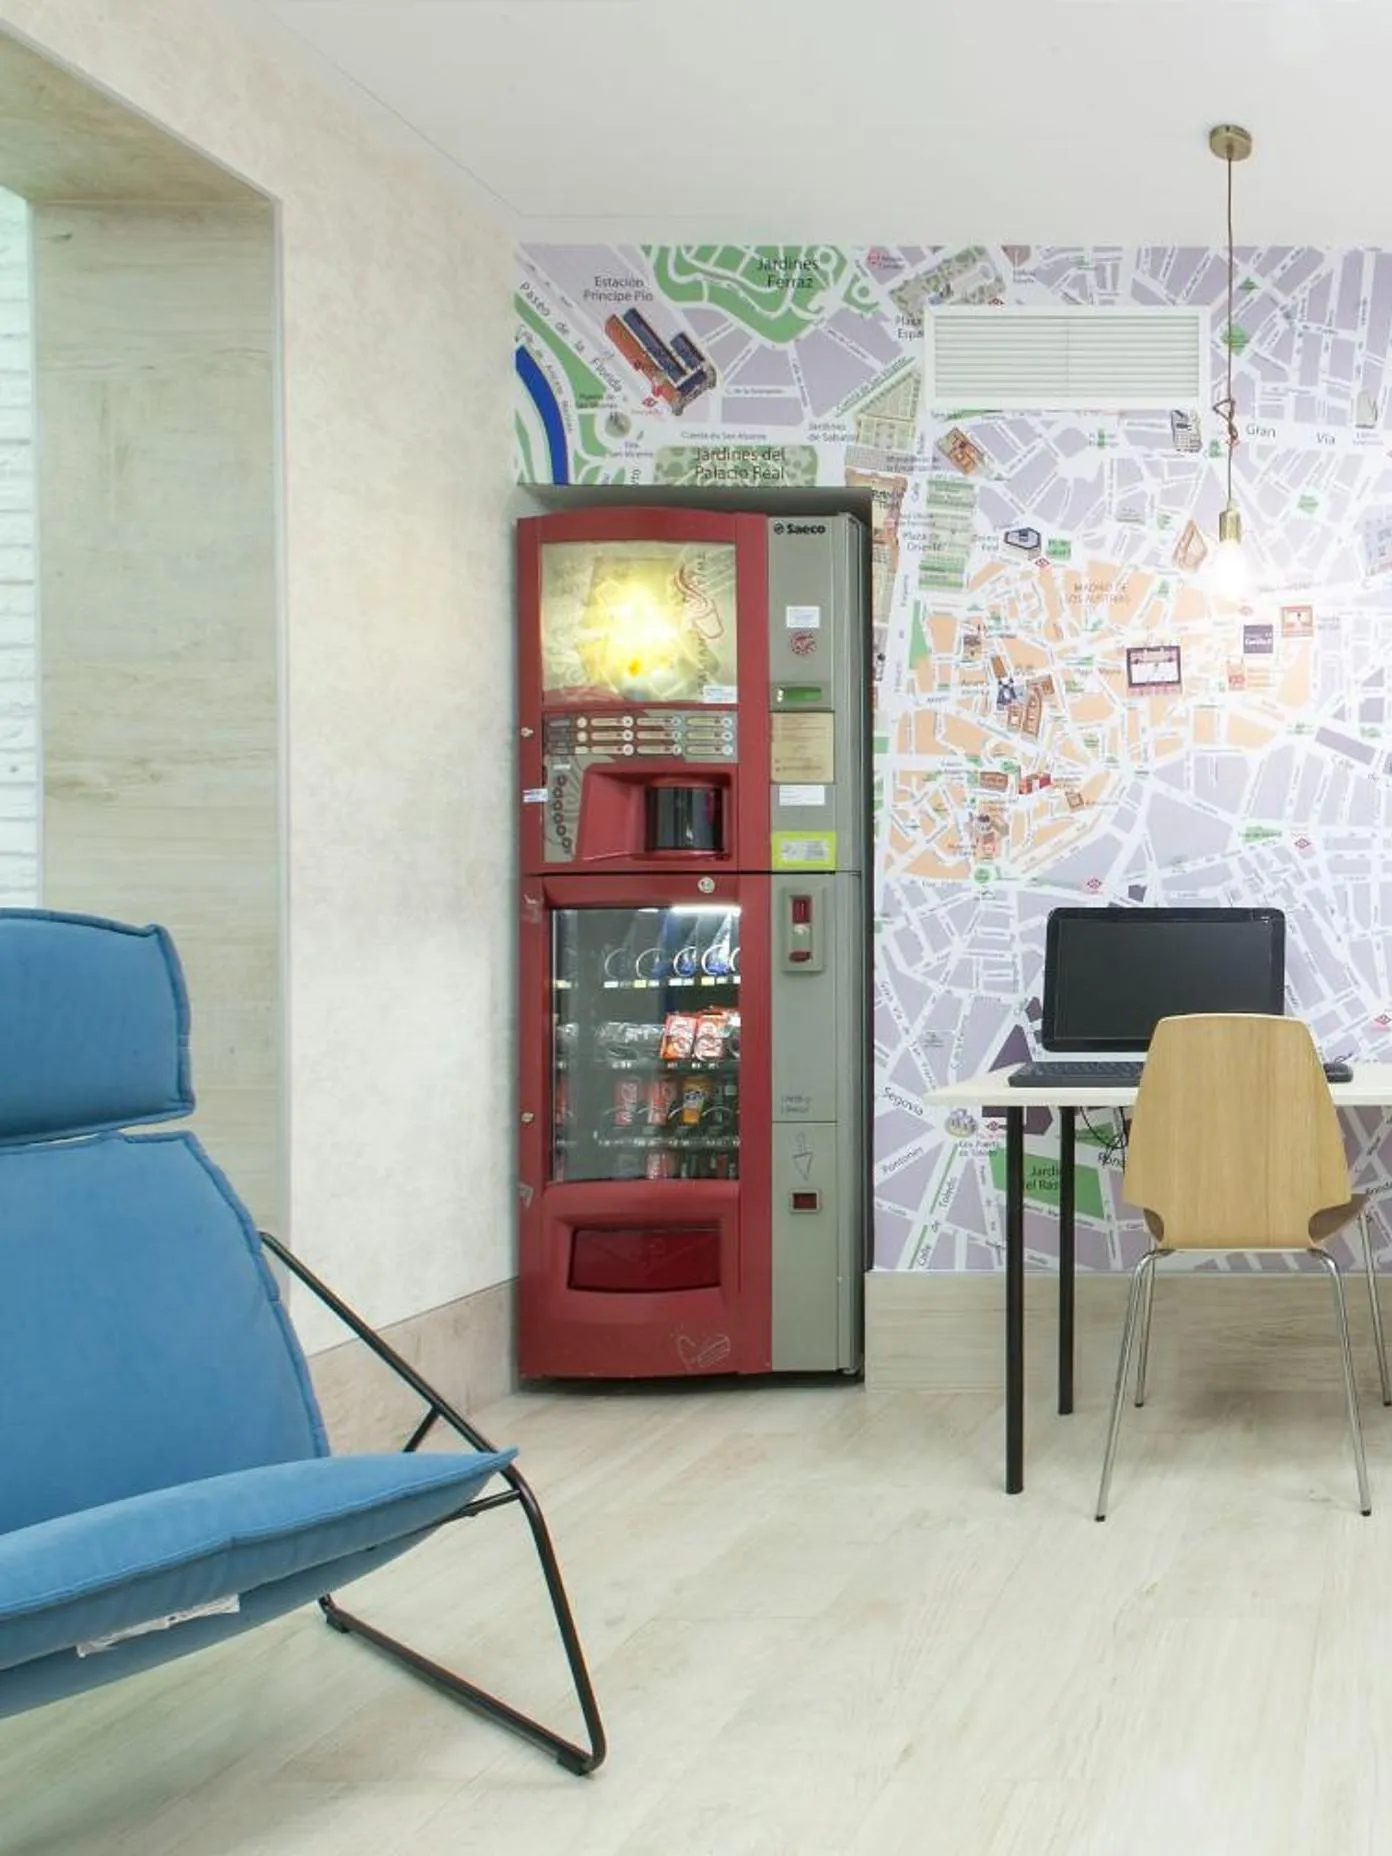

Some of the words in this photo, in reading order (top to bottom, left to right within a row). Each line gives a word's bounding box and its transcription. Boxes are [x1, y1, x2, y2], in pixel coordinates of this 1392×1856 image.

[756, 256, 820, 271] Jardines
[767, 274, 814, 289] Ferraz
[1245, 424, 1277, 438] Gran
[694, 446, 757, 462] Jardines
[762, 446, 786, 462] del
[694, 465, 749, 480] Palacio
[753, 465, 785, 480] Real
[787, 523, 826, 535] Saeco
[883, 1086, 924, 1117] Segovia
